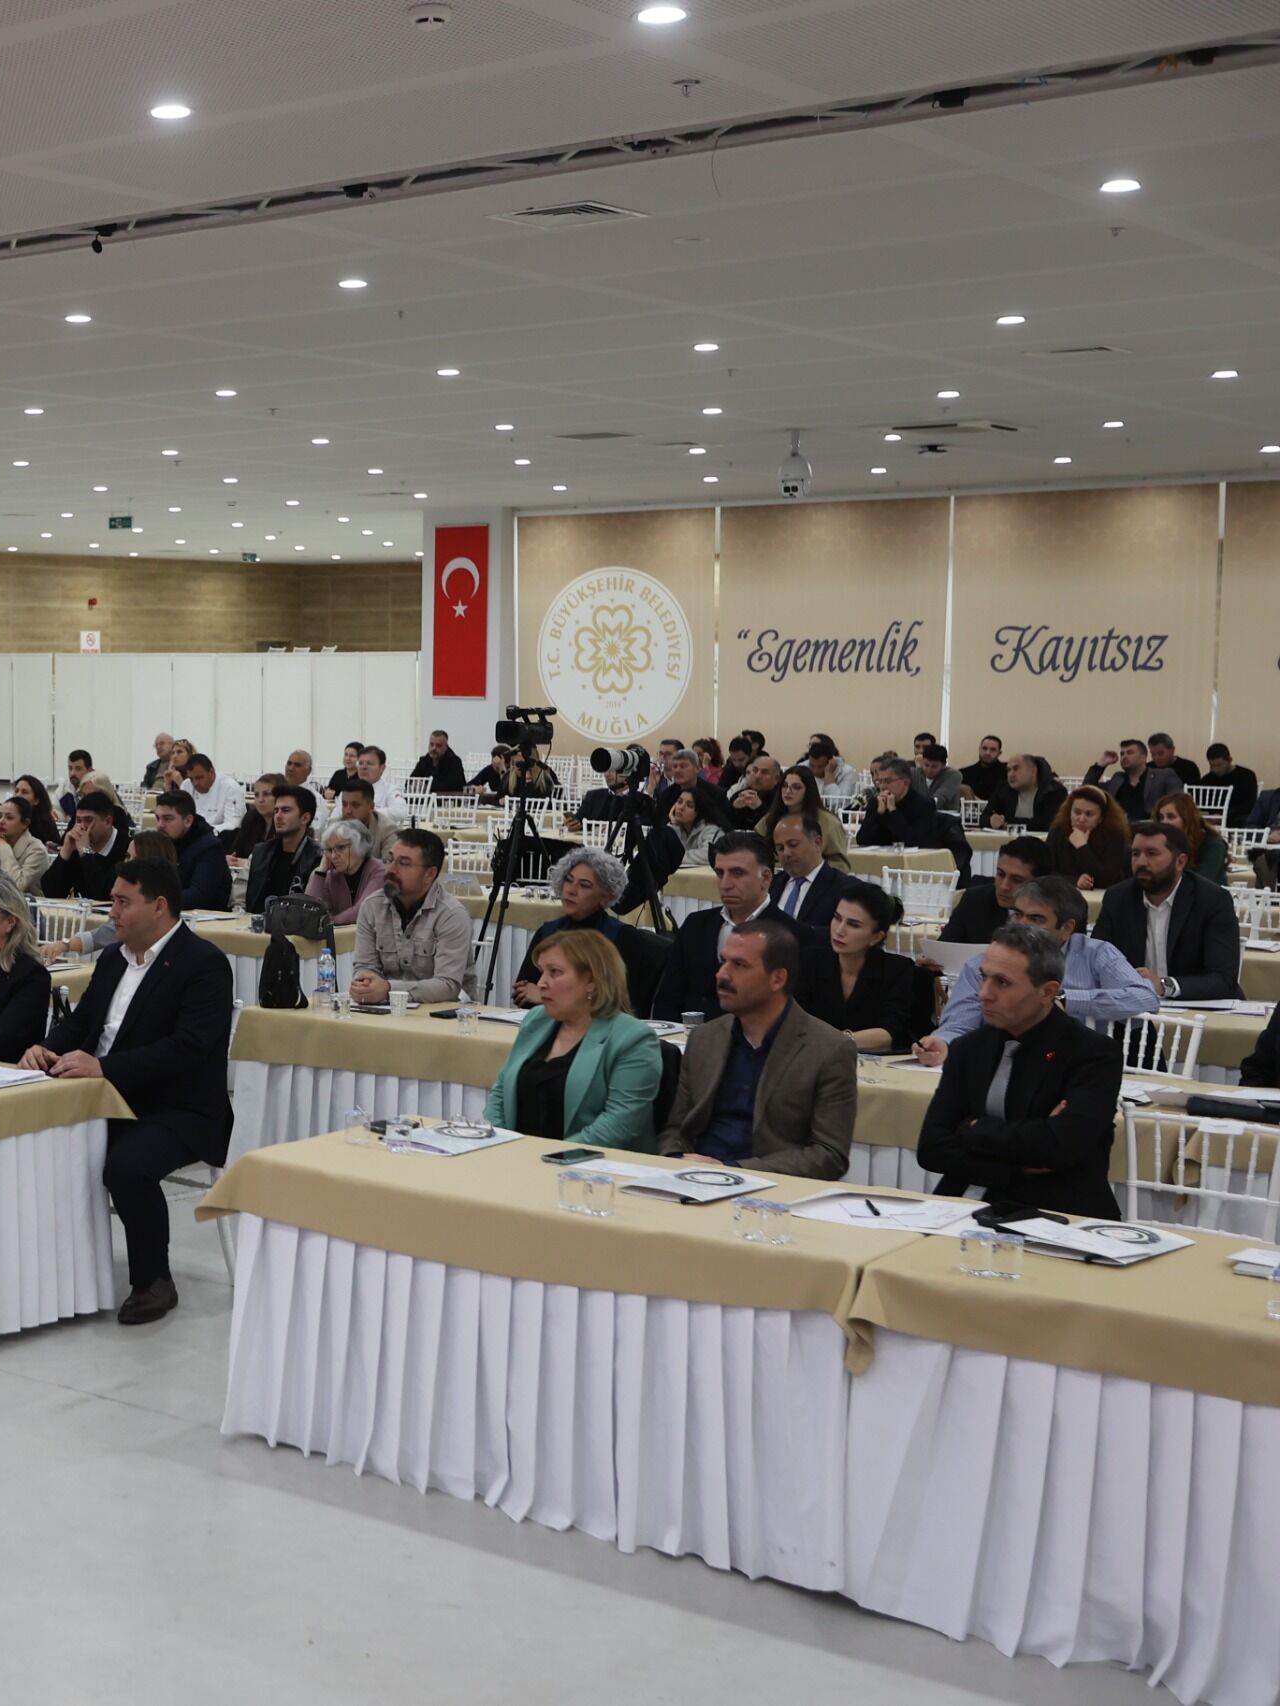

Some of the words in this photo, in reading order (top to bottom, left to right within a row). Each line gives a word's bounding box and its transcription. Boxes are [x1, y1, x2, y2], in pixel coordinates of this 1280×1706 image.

[550, 574, 635, 640] BÜYÜKŞEHİR
[639, 586, 681, 681] BELEDİYESİ
[547, 647, 561, 680] T.C.
[990, 624, 1168, 683] Kayıtsız
[577, 711, 649, 736] MUĞLA
